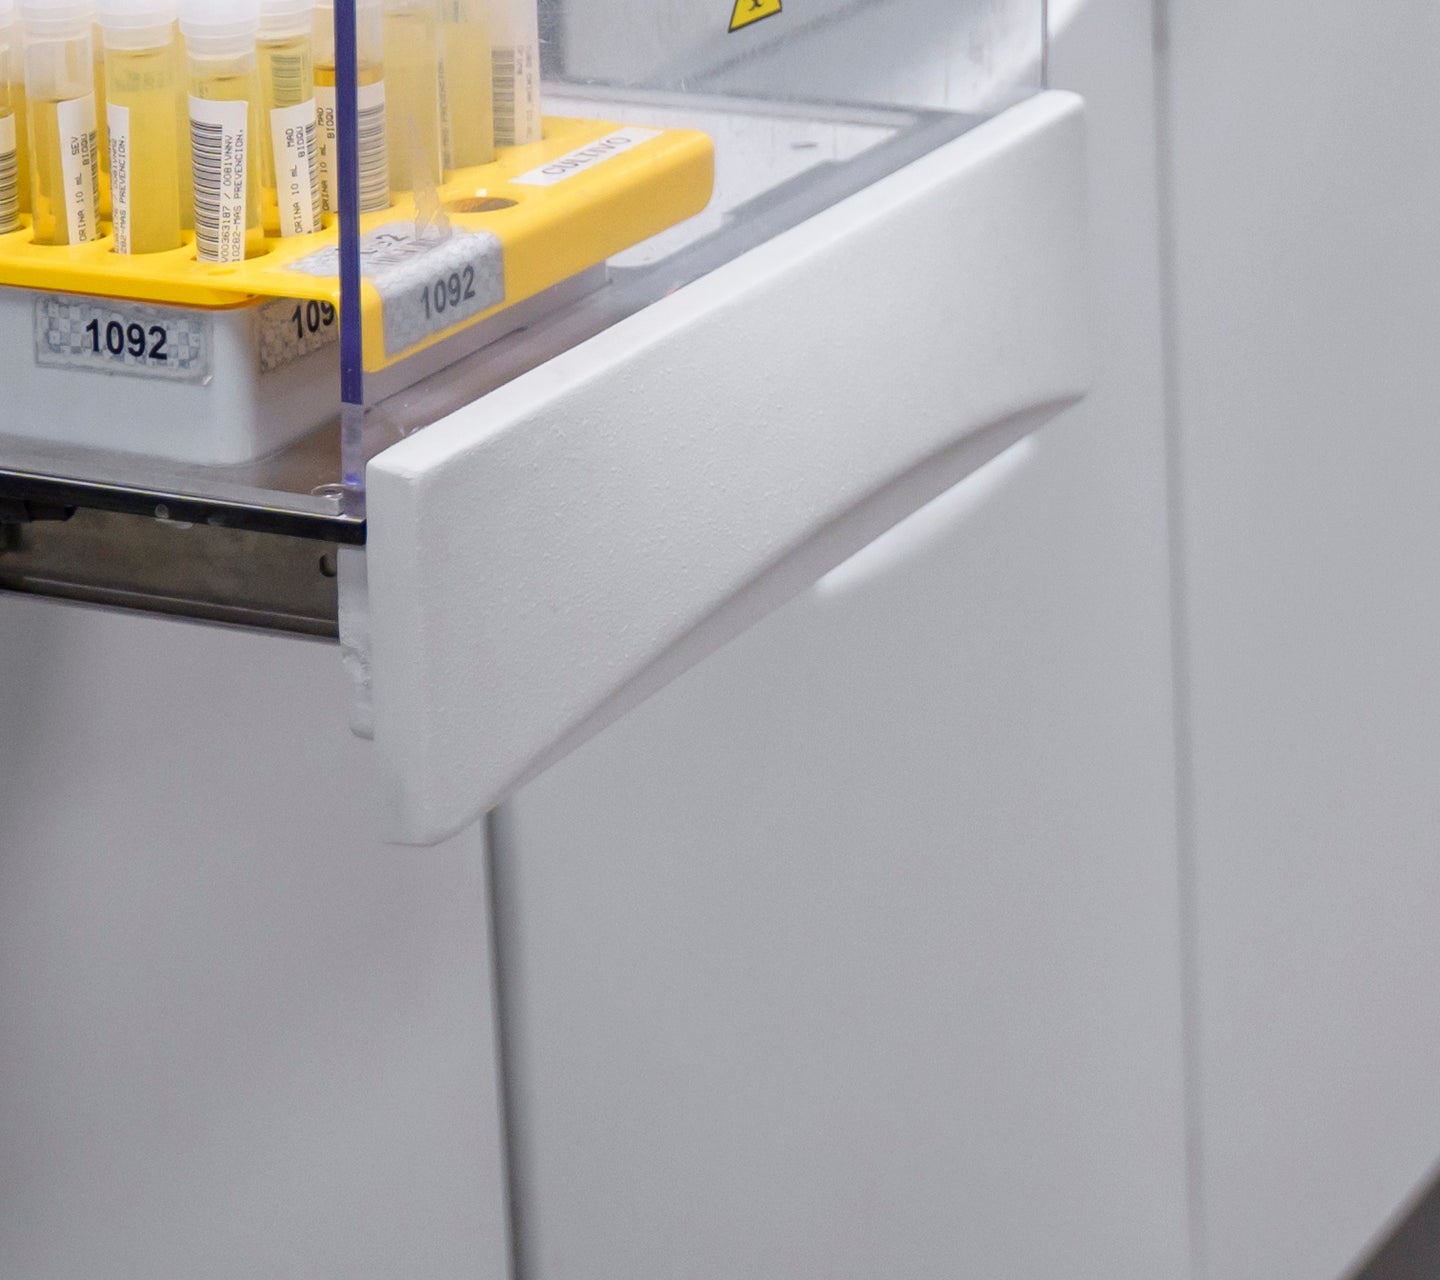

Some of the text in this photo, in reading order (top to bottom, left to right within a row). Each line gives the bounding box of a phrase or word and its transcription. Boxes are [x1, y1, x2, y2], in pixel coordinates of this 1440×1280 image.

[296, 126, 305, 158] BIOQU
[326, 108, 335, 139] BIOQU
[81, 133, 90, 165] BIOQU
[234, 128, 243, 199] PREVENCION.
[316, 107, 329, 211] ORINA 10 mL MAD
[71, 136, 87, 241] ORINA 10 mL SEV
[285, 128, 303, 233] ORINA 10 mL MAD
[421, 264, 476, 320] 1092
[85, 318, 168, 360] 1092
[292, 300, 336, 339] 109
